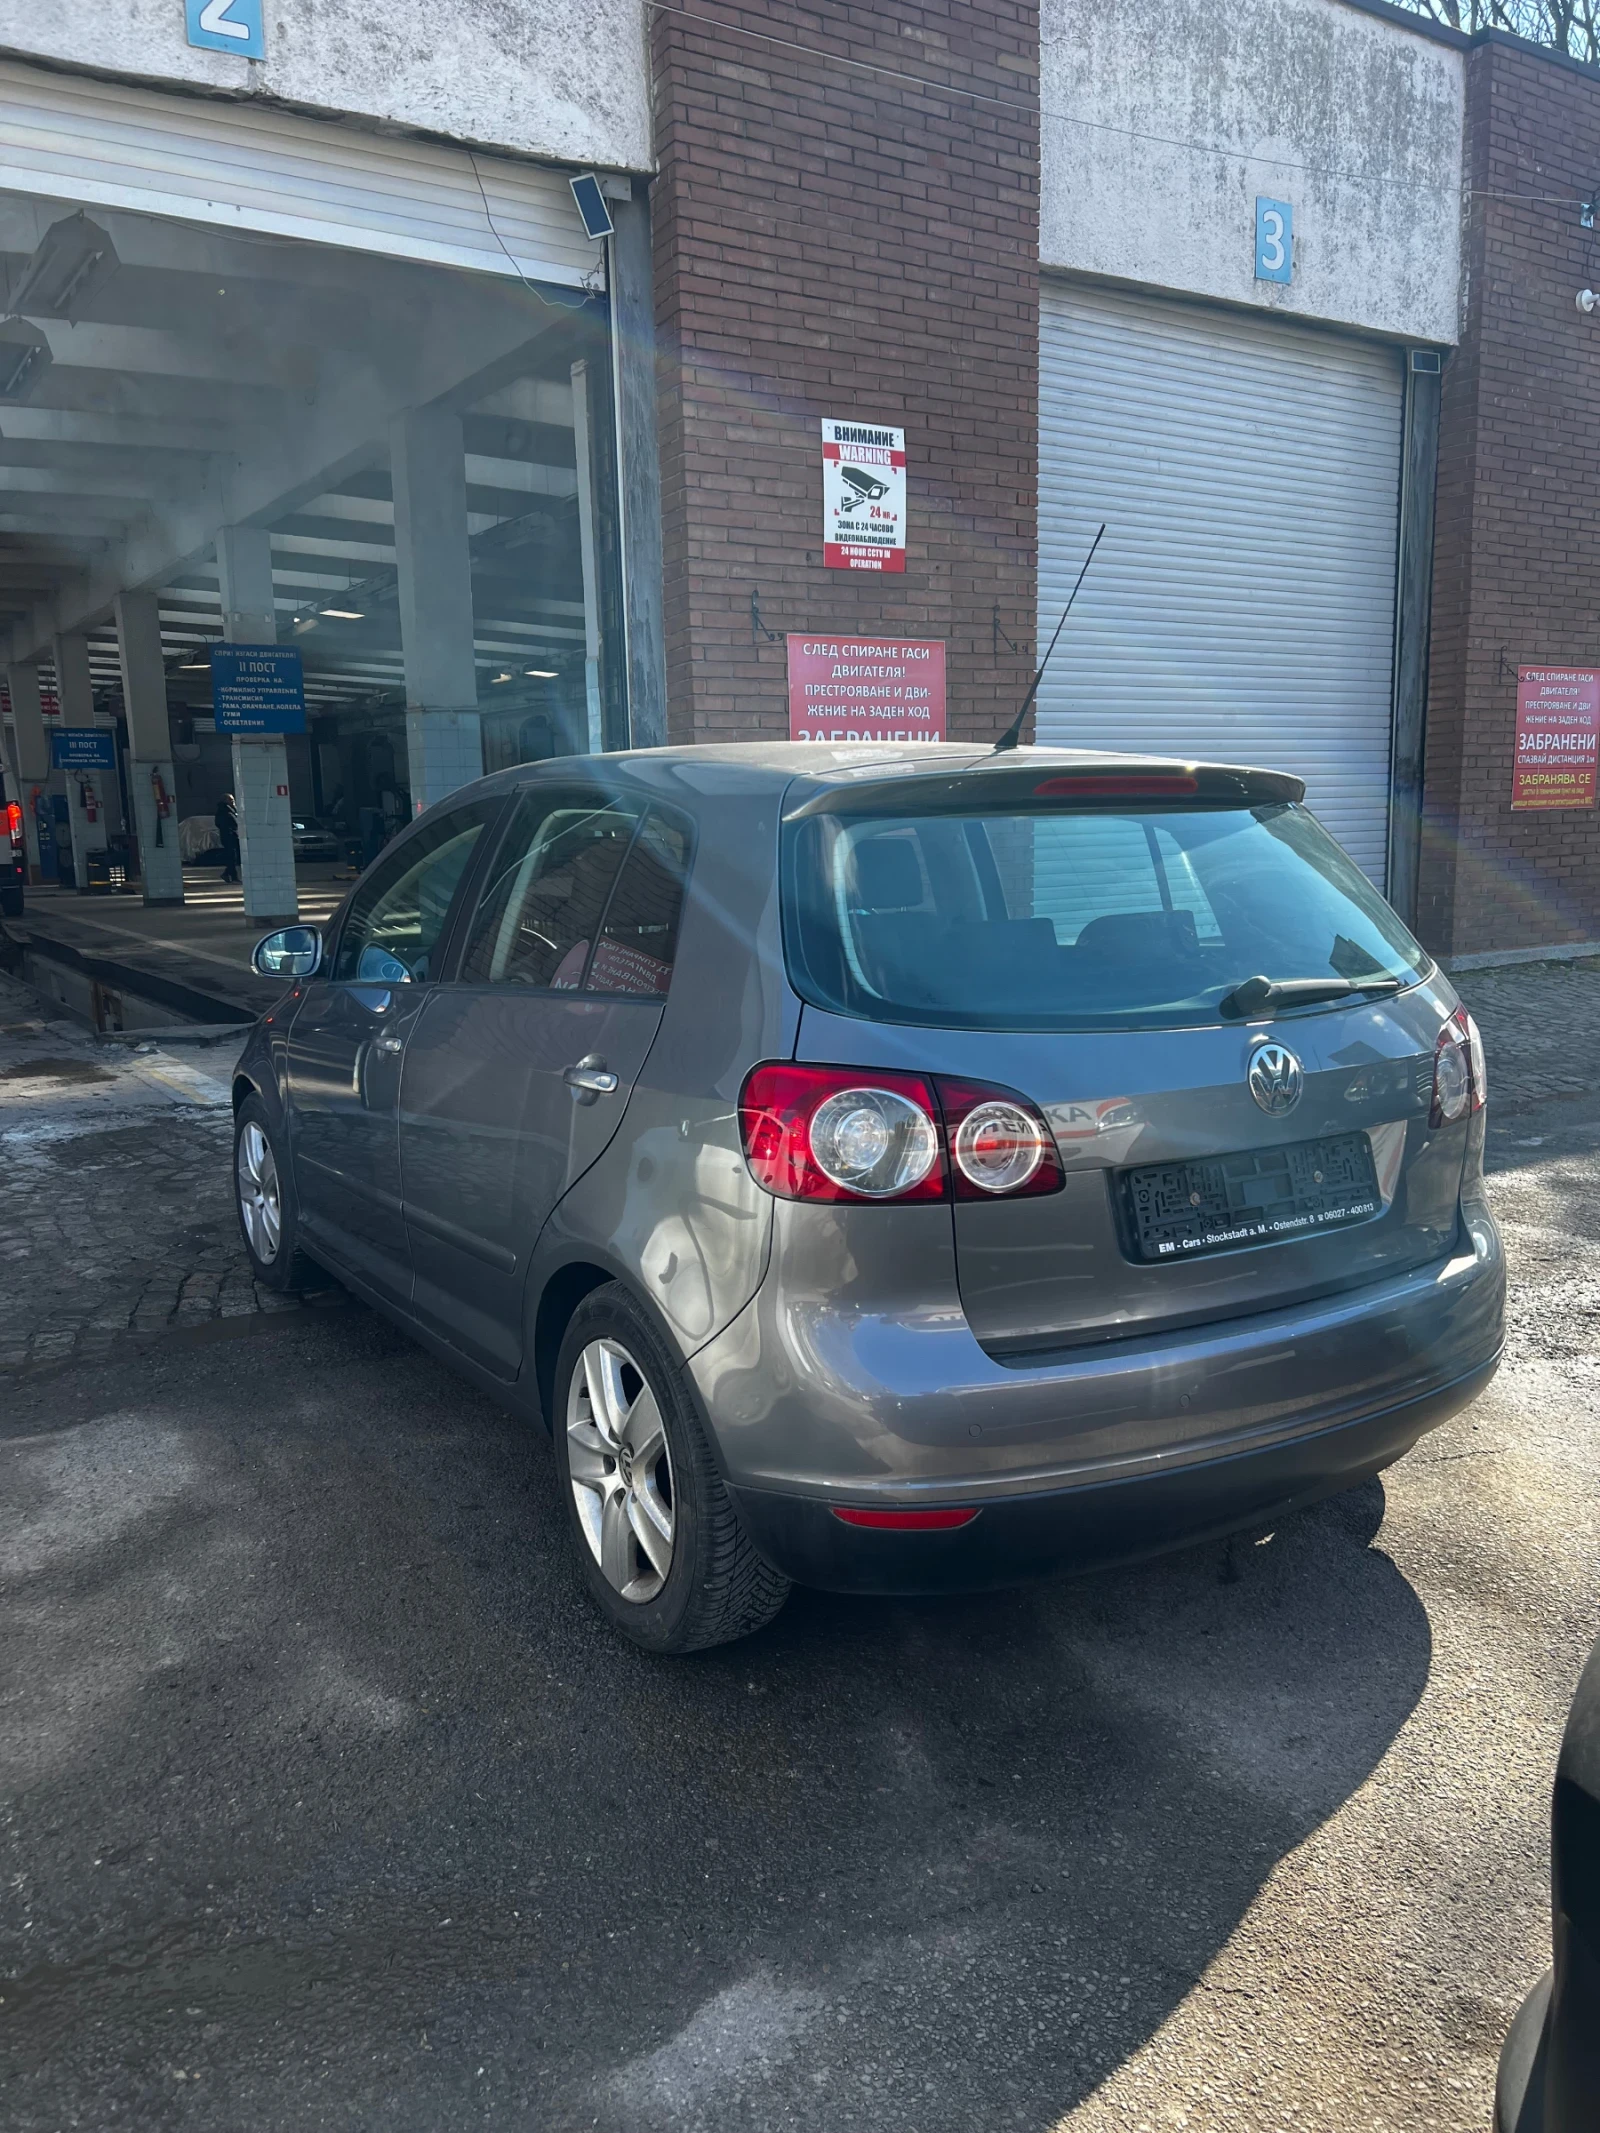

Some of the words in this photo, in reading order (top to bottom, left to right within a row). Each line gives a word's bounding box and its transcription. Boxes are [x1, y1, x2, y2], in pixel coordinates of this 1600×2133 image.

[1262, 210, 1285, 270] 3
[834, 425, 895, 448] ВНИМАНИЕ
[838, 444, 892, 466] WARNING
[870, 505, 881, 518] 24
[837, 520, 855, 530] ЗОНА
[861, 522, 869, 531] 24
[869, 522, 894, 534] ЧАСОВО
[834, 533, 897, 546] ВИДЕОНАБЛЮДЕНИЕ
[841, 545, 849, 556] 24
[849, 546, 867, 557] HOUR
[867, 548, 883, 558] CCTV
[850, 558, 882, 570] OPERATION
[803, 643, 838, 658] СЛЕД
[842, 644, 898, 659] СПИРАНЕ
[901, 647, 930, 660] ГАСИ
[249, 662, 277, 673] ПОСТ
[831, 664, 906, 679] ДВИГАТЕЛЯ!
[1526, 672, 1545, 682] СЛЕД
[1546, 672, 1577, 682] СПИРАНЕ
[1578, 673, 1594, 682] ГАСИ
[805, 684, 891, 698] ПРЕСТРОЯВАНЕ
[894, 687, 901, 698] И
[904, 687, 931, 700] ДВИ-
[807, 704, 847, 717] ЖЕНИЕ
[850, 705, 866, 717] НА
[869, 706, 905, 719] ЗАДЕН
[907, 706, 930, 720] ХОД
[1525, 701, 1572, 710] ПРЕСТРОЯВАНЕ
[1525, 715, 1547, 724] ЖЕНИЕ
[1548, 716, 1557, 724] НА
[1558, 716, 1578, 725] ЗАДЕН
[1579, 716, 1591, 725] ХОД
[1519, 733, 1596, 750] ЗАБРАНЕНИ
[1517, 753, 1547, 764] СПАЗВАЙ
[1547, 755, 1585, 765] ДИСТАНЦИЯ
[1519, 774, 1576, 785] ЗАБРАНЯВА
[1578, 773, 1592, 784] СЕ
[1249, 1043, 1302, 1117] VW
[1159, 1242, 1175, 1253] EM
[1182, 1238, 1201, 1249] Cars
[1206, 1228, 1248, 1244] Stockstadt
[1250, 1228, 1256, 1236] a.
[1257, 1224, 1268, 1234] M.
[1273, 1217, 1308, 1231] Ostendstr.
[1309, 1215, 1315, 1223] 8
[1324, 1209, 1345, 1220] 06027
